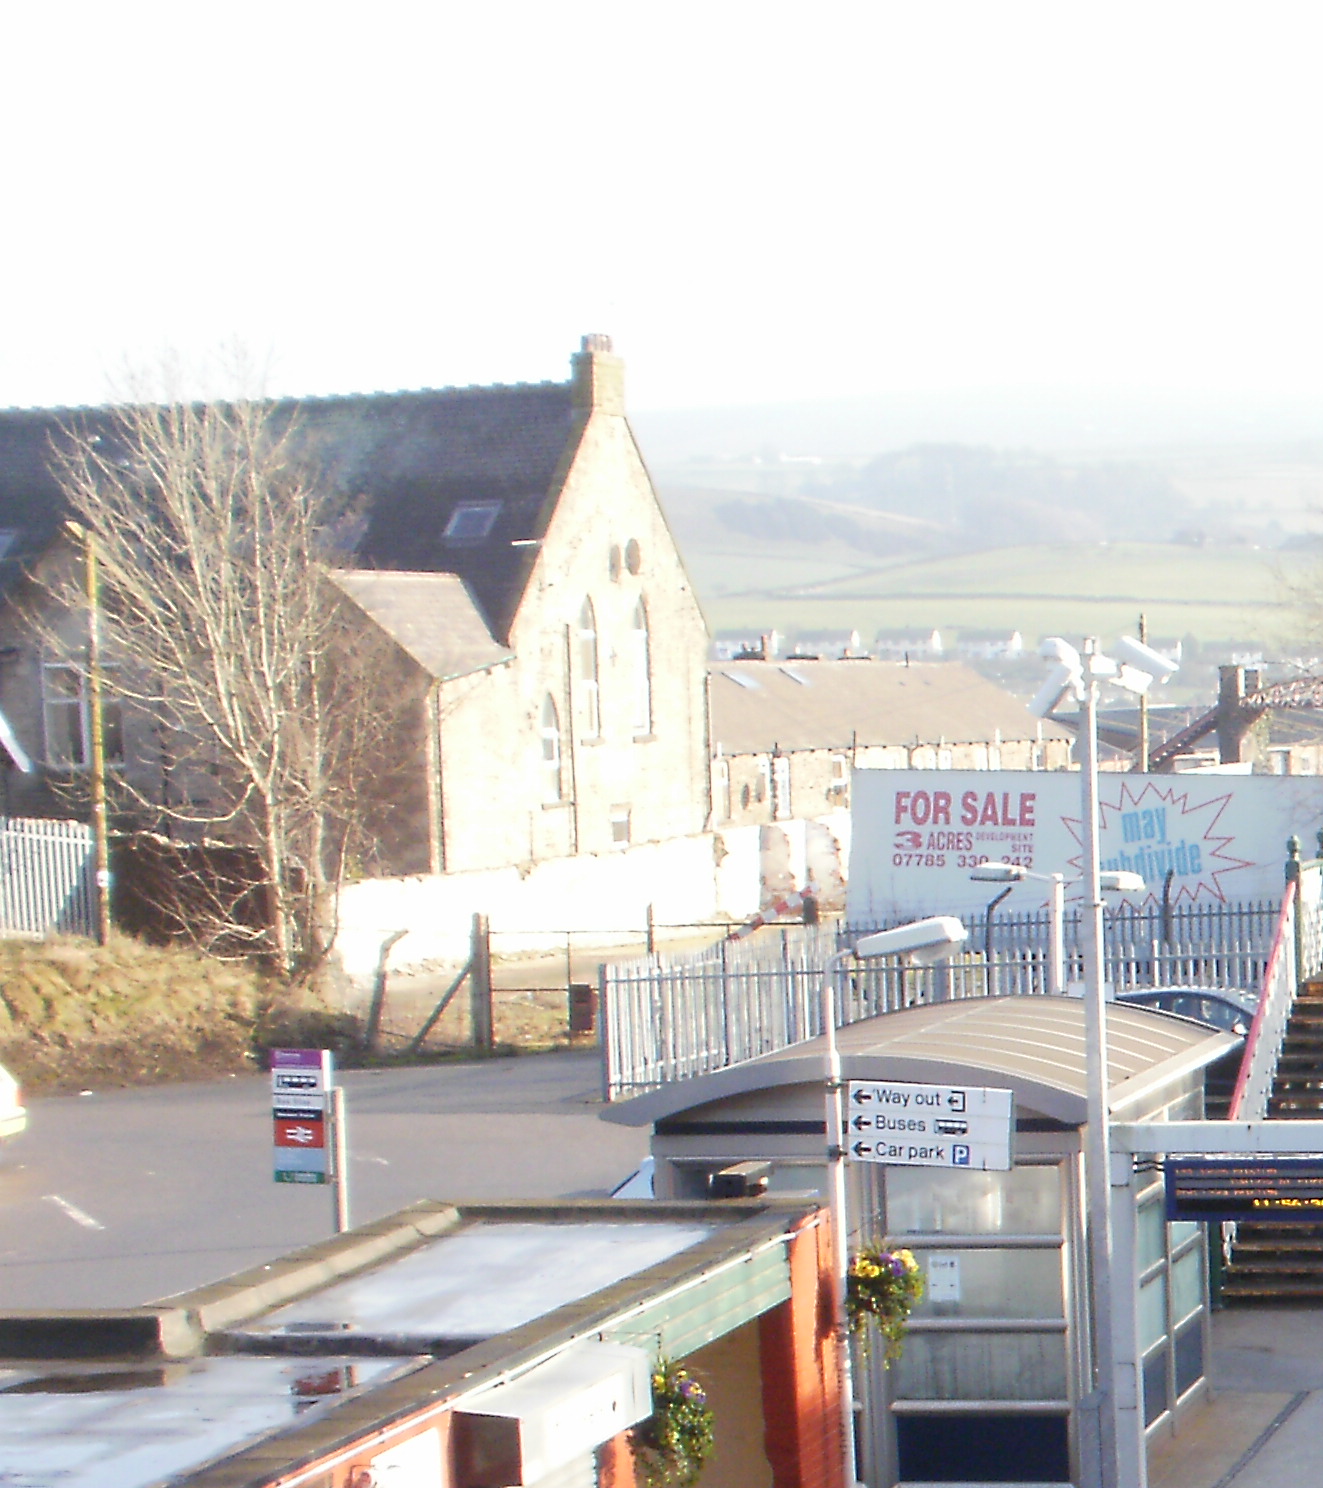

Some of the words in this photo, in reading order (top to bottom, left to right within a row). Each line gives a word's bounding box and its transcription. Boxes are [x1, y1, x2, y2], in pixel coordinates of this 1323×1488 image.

[894, 790, 952, 826] FOR
[960, 790, 1037, 827] SALE
[1121, 806, 1166, 845] may
[893, 829, 923, 849] 3
[926, 831, 973, 851] ACRES
[975, 831, 1034, 842] DEVELOPMENT
[892, 853, 946, 868] 07785
[957, 854, 990, 868] 330
[1099, 839, 1203, 883] bdivide
[873, 1090, 911, 1107] Way
[915, 1091, 942, 1107] out
[875, 1114, 926, 1132] Buses
[875, 1141, 903, 1157] Car
[908, 1144, 946, 1161] park
